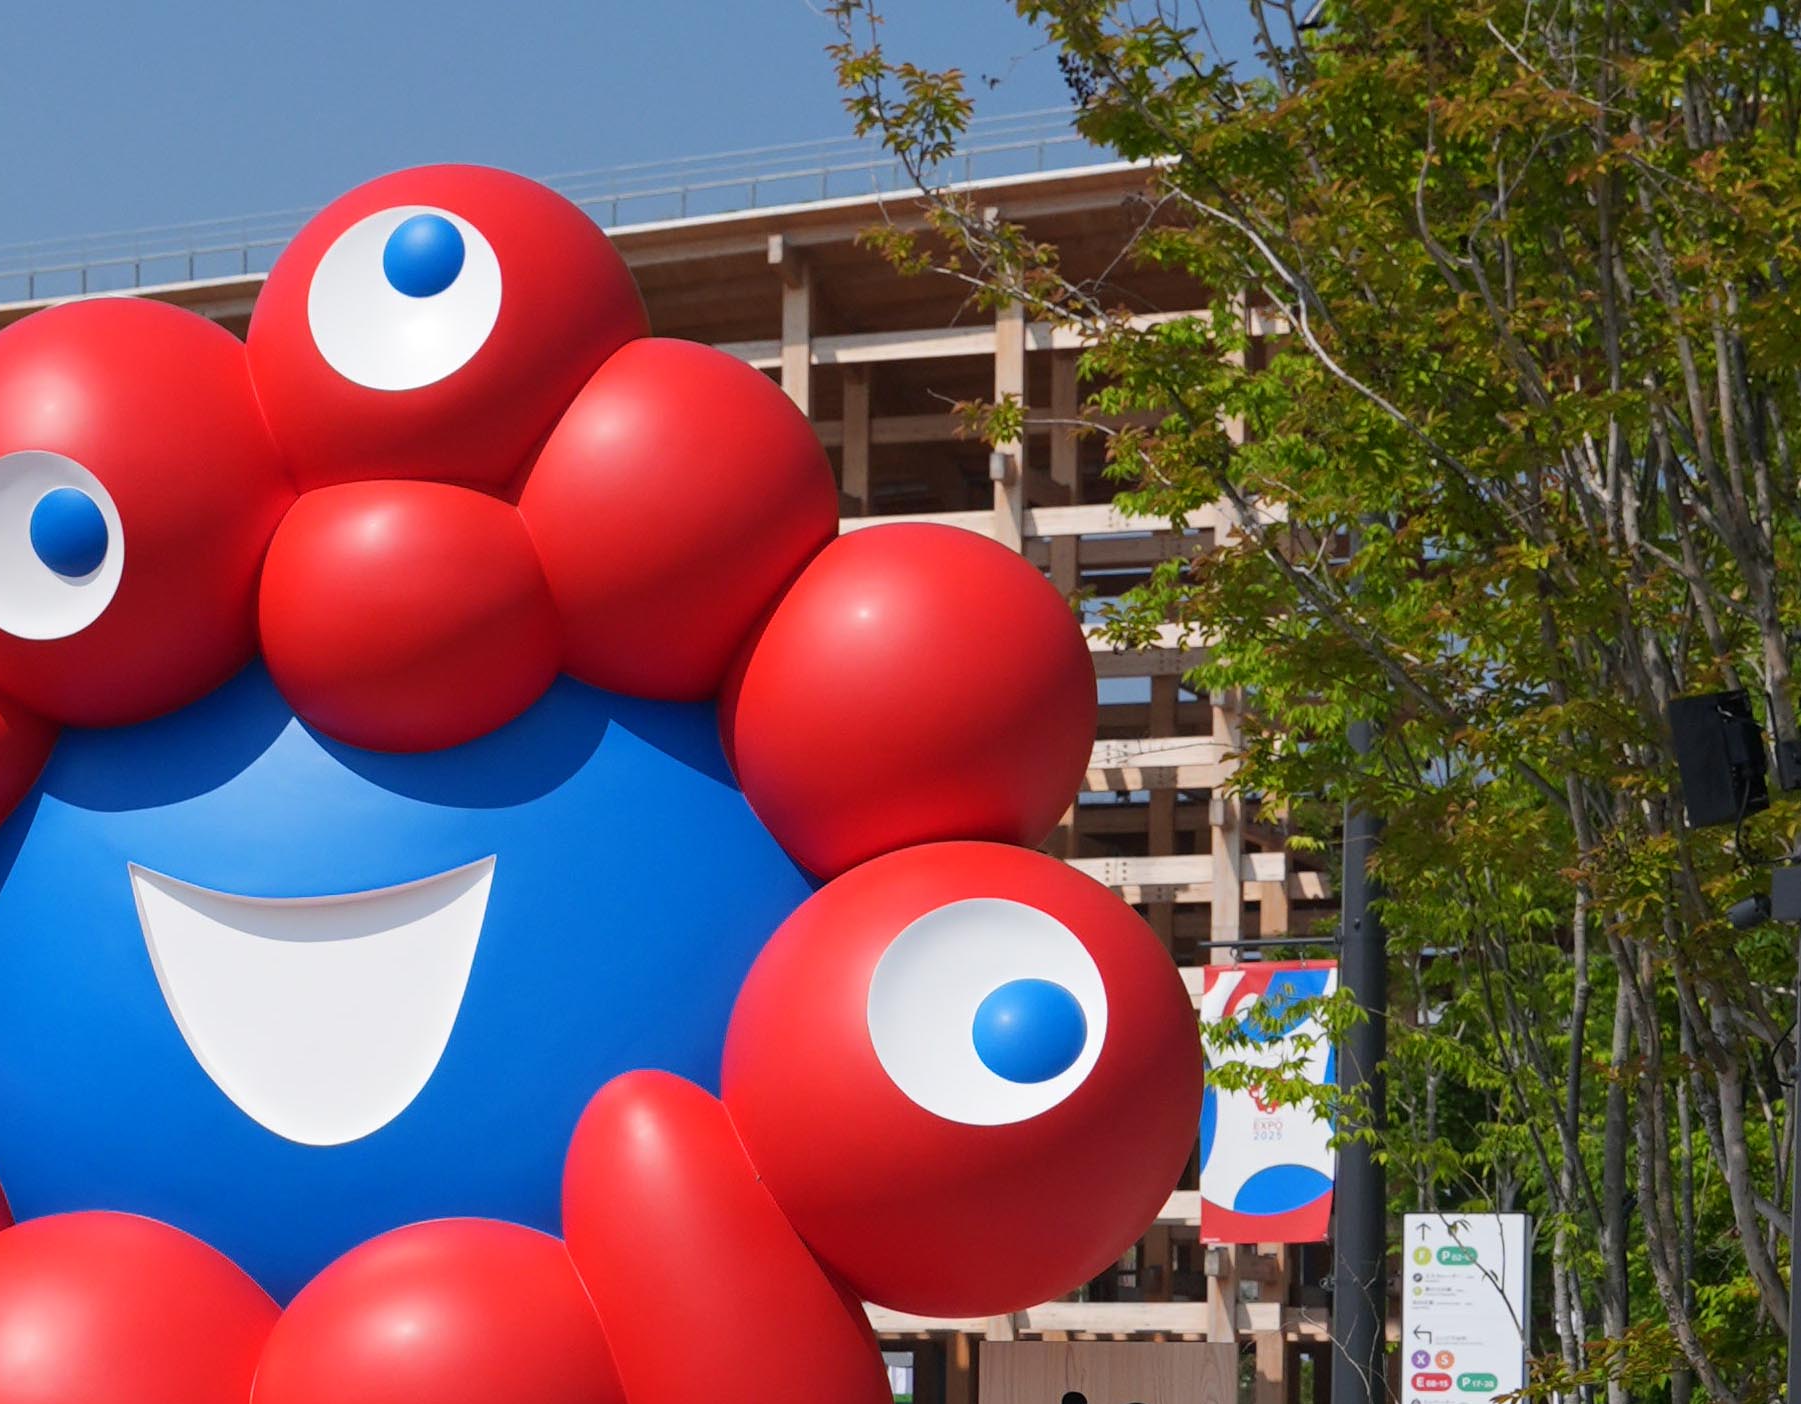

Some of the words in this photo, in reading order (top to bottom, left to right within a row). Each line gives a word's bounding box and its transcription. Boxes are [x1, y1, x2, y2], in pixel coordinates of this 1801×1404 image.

[1253, 1120, 1283, 1131] EXPO
[1253, 1131, 1283, 1141] 2025
[1416, 1354, 1426, 1365] X
[1440, 1354, 1449, 1365] S
